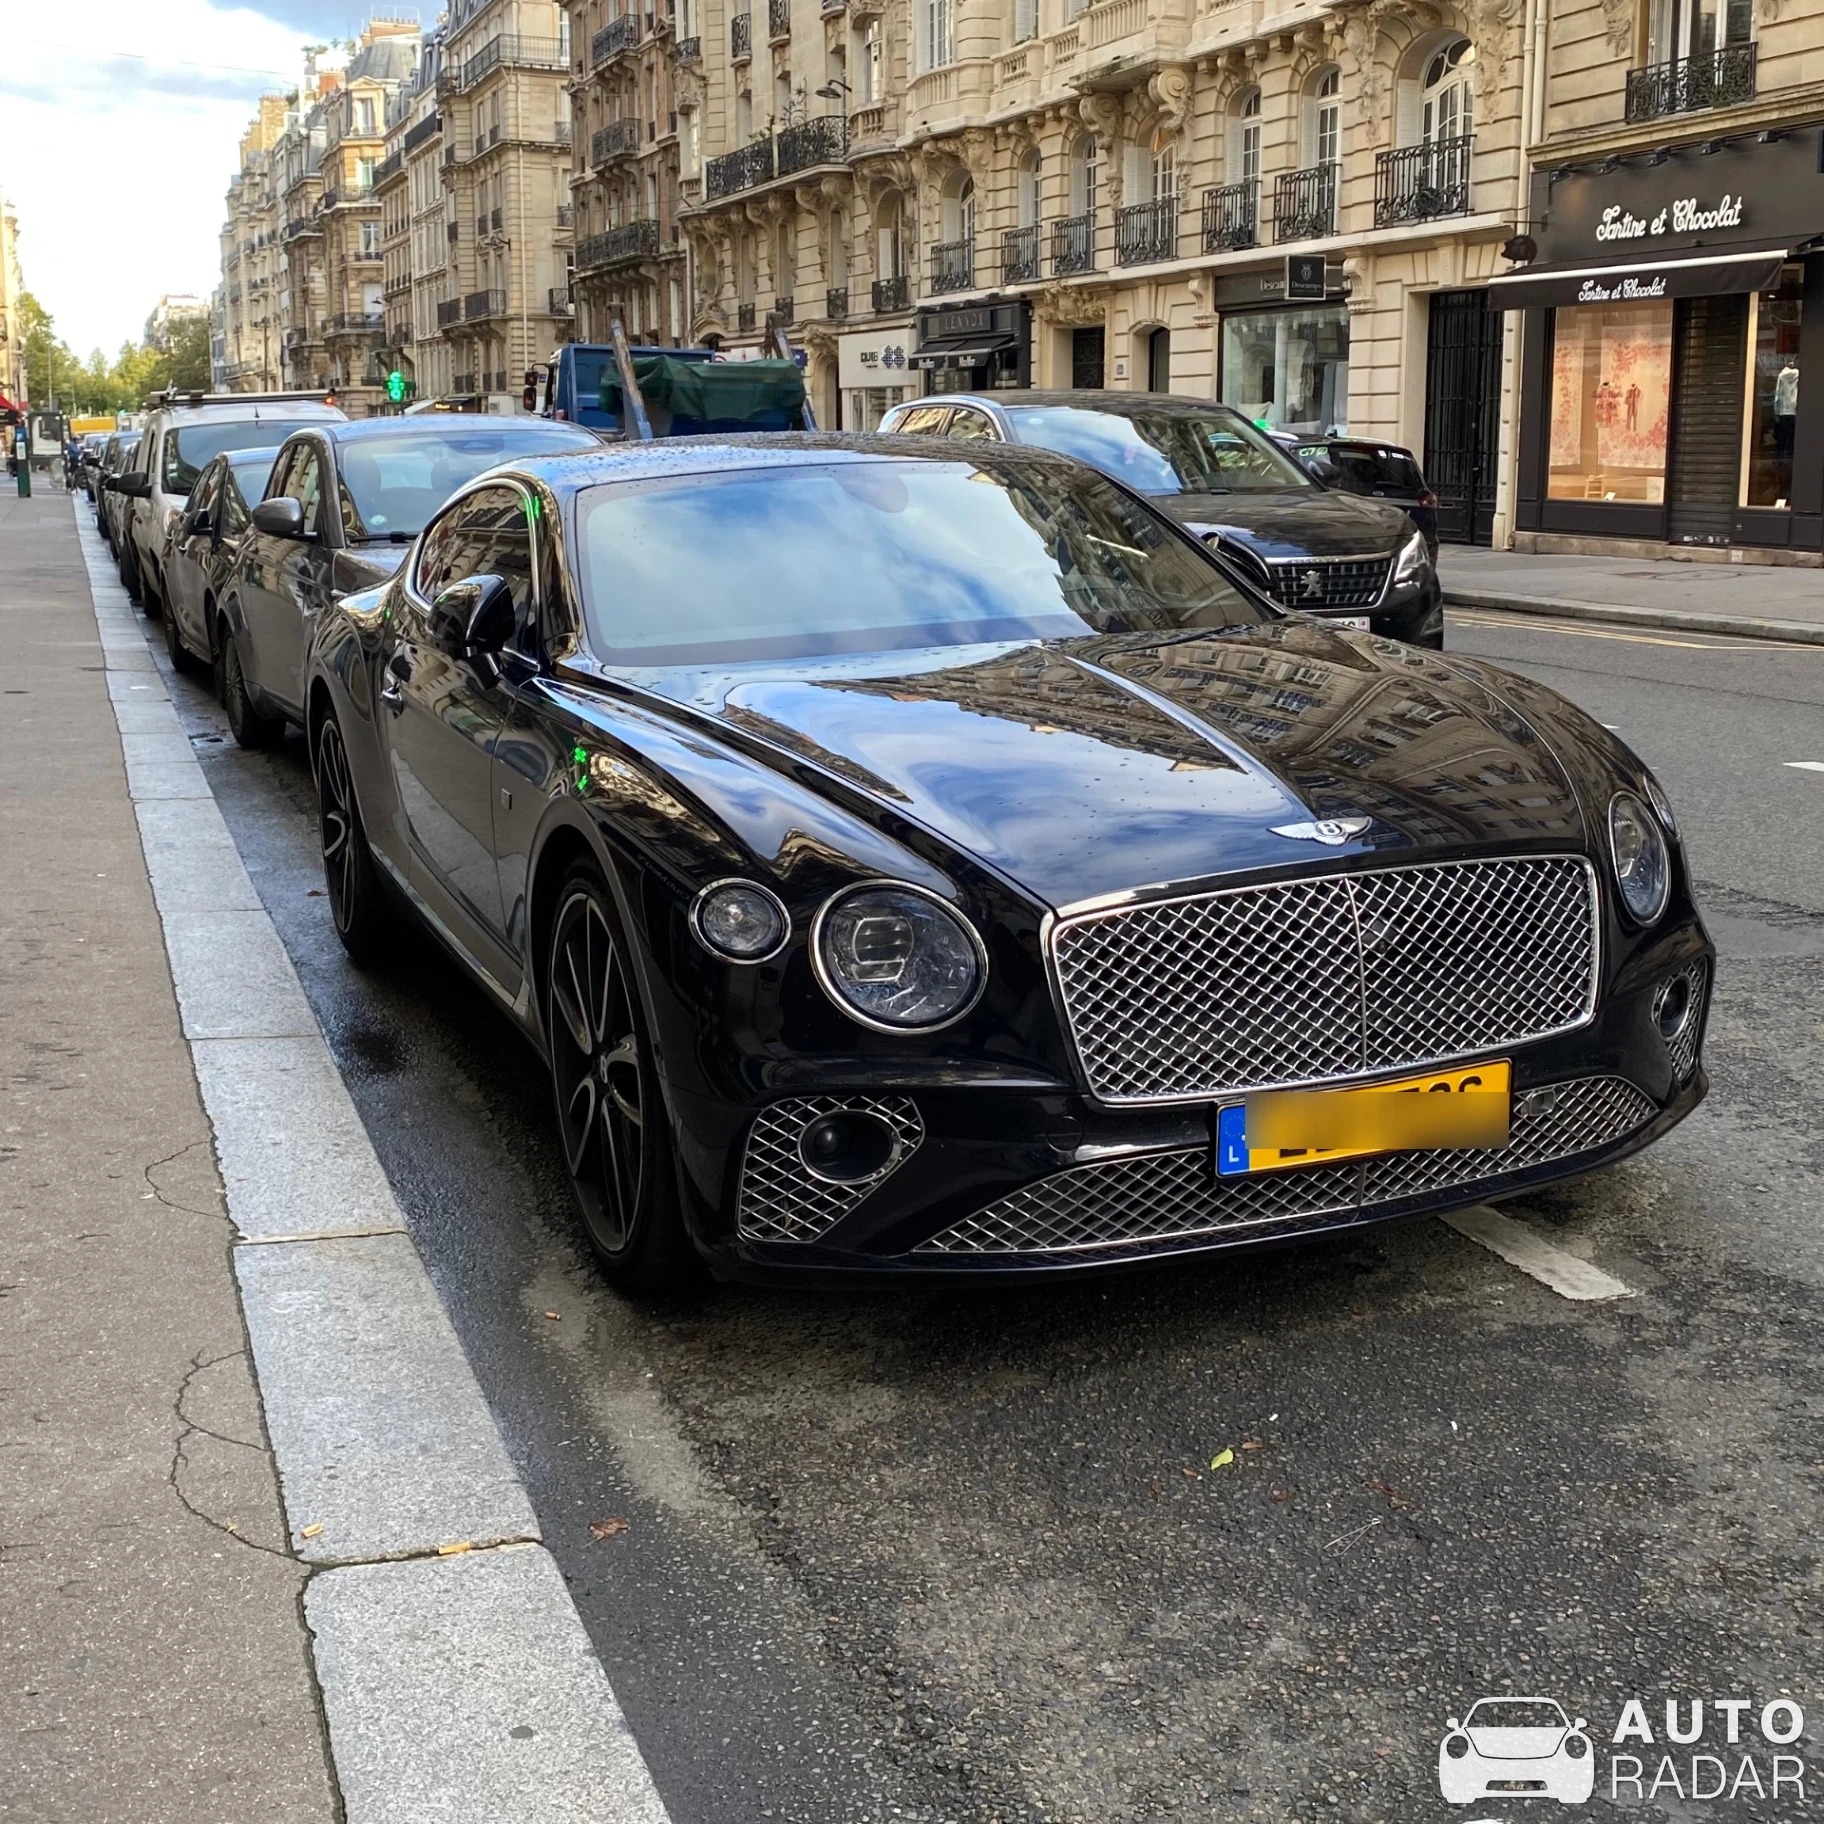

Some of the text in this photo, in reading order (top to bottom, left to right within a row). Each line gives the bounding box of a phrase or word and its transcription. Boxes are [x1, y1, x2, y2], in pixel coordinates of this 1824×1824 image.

[1596, 194, 1742, 241] Tartine et Chocolat
[1291, 281, 1322, 291] Descamps
[1578, 276, 1667, 301] Tartine et Chocolat
[1299, 447, 1316, 457] G7
[1228, 1145, 1240, 1163] L
